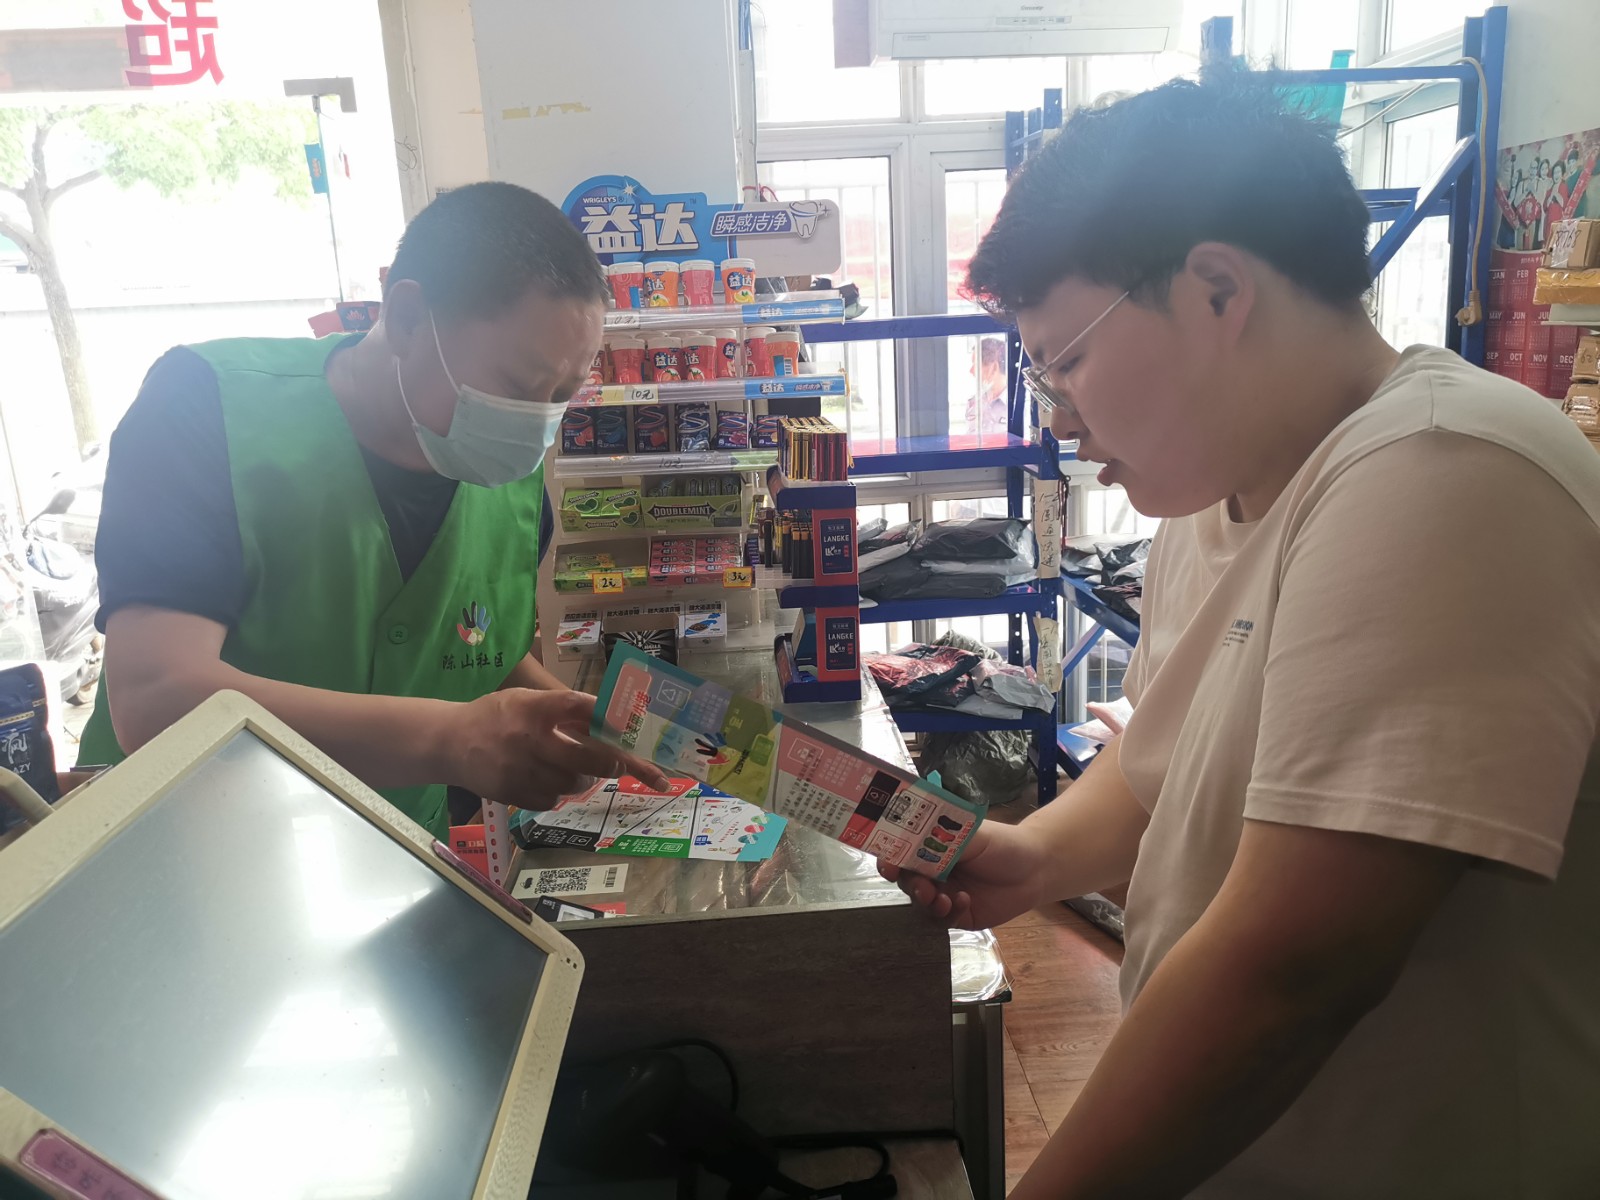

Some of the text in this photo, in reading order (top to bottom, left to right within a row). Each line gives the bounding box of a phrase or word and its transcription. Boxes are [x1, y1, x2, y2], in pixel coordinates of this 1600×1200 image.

[583, 196, 617, 205] WRIGLEY'S
[716, 212, 788, 232] 瞬感洁净
[580, 202, 700, 254] 益达
[1492, 271, 1505, 279] JAN
[1516, 269, 1529, 278] FEB
[729, 272, 753, 287] 益达
[1512, 311, 1526, 320] JUN
[655, 353, 678, 366] 益达
[1486, 351, 1499, 360] SEP
[1509, 353, 1523, 361] OCT
[1533, 354, 1547, 363] NOV
[1559, 355, 1574, 364] DEC
[653, 505, 712, 517] DOUBLEMINT
[823, 534, 850, 543] LANGKE
[828, 632, 854, 640] LANGKE
[442, 651, 504, 670] 陈山社区
